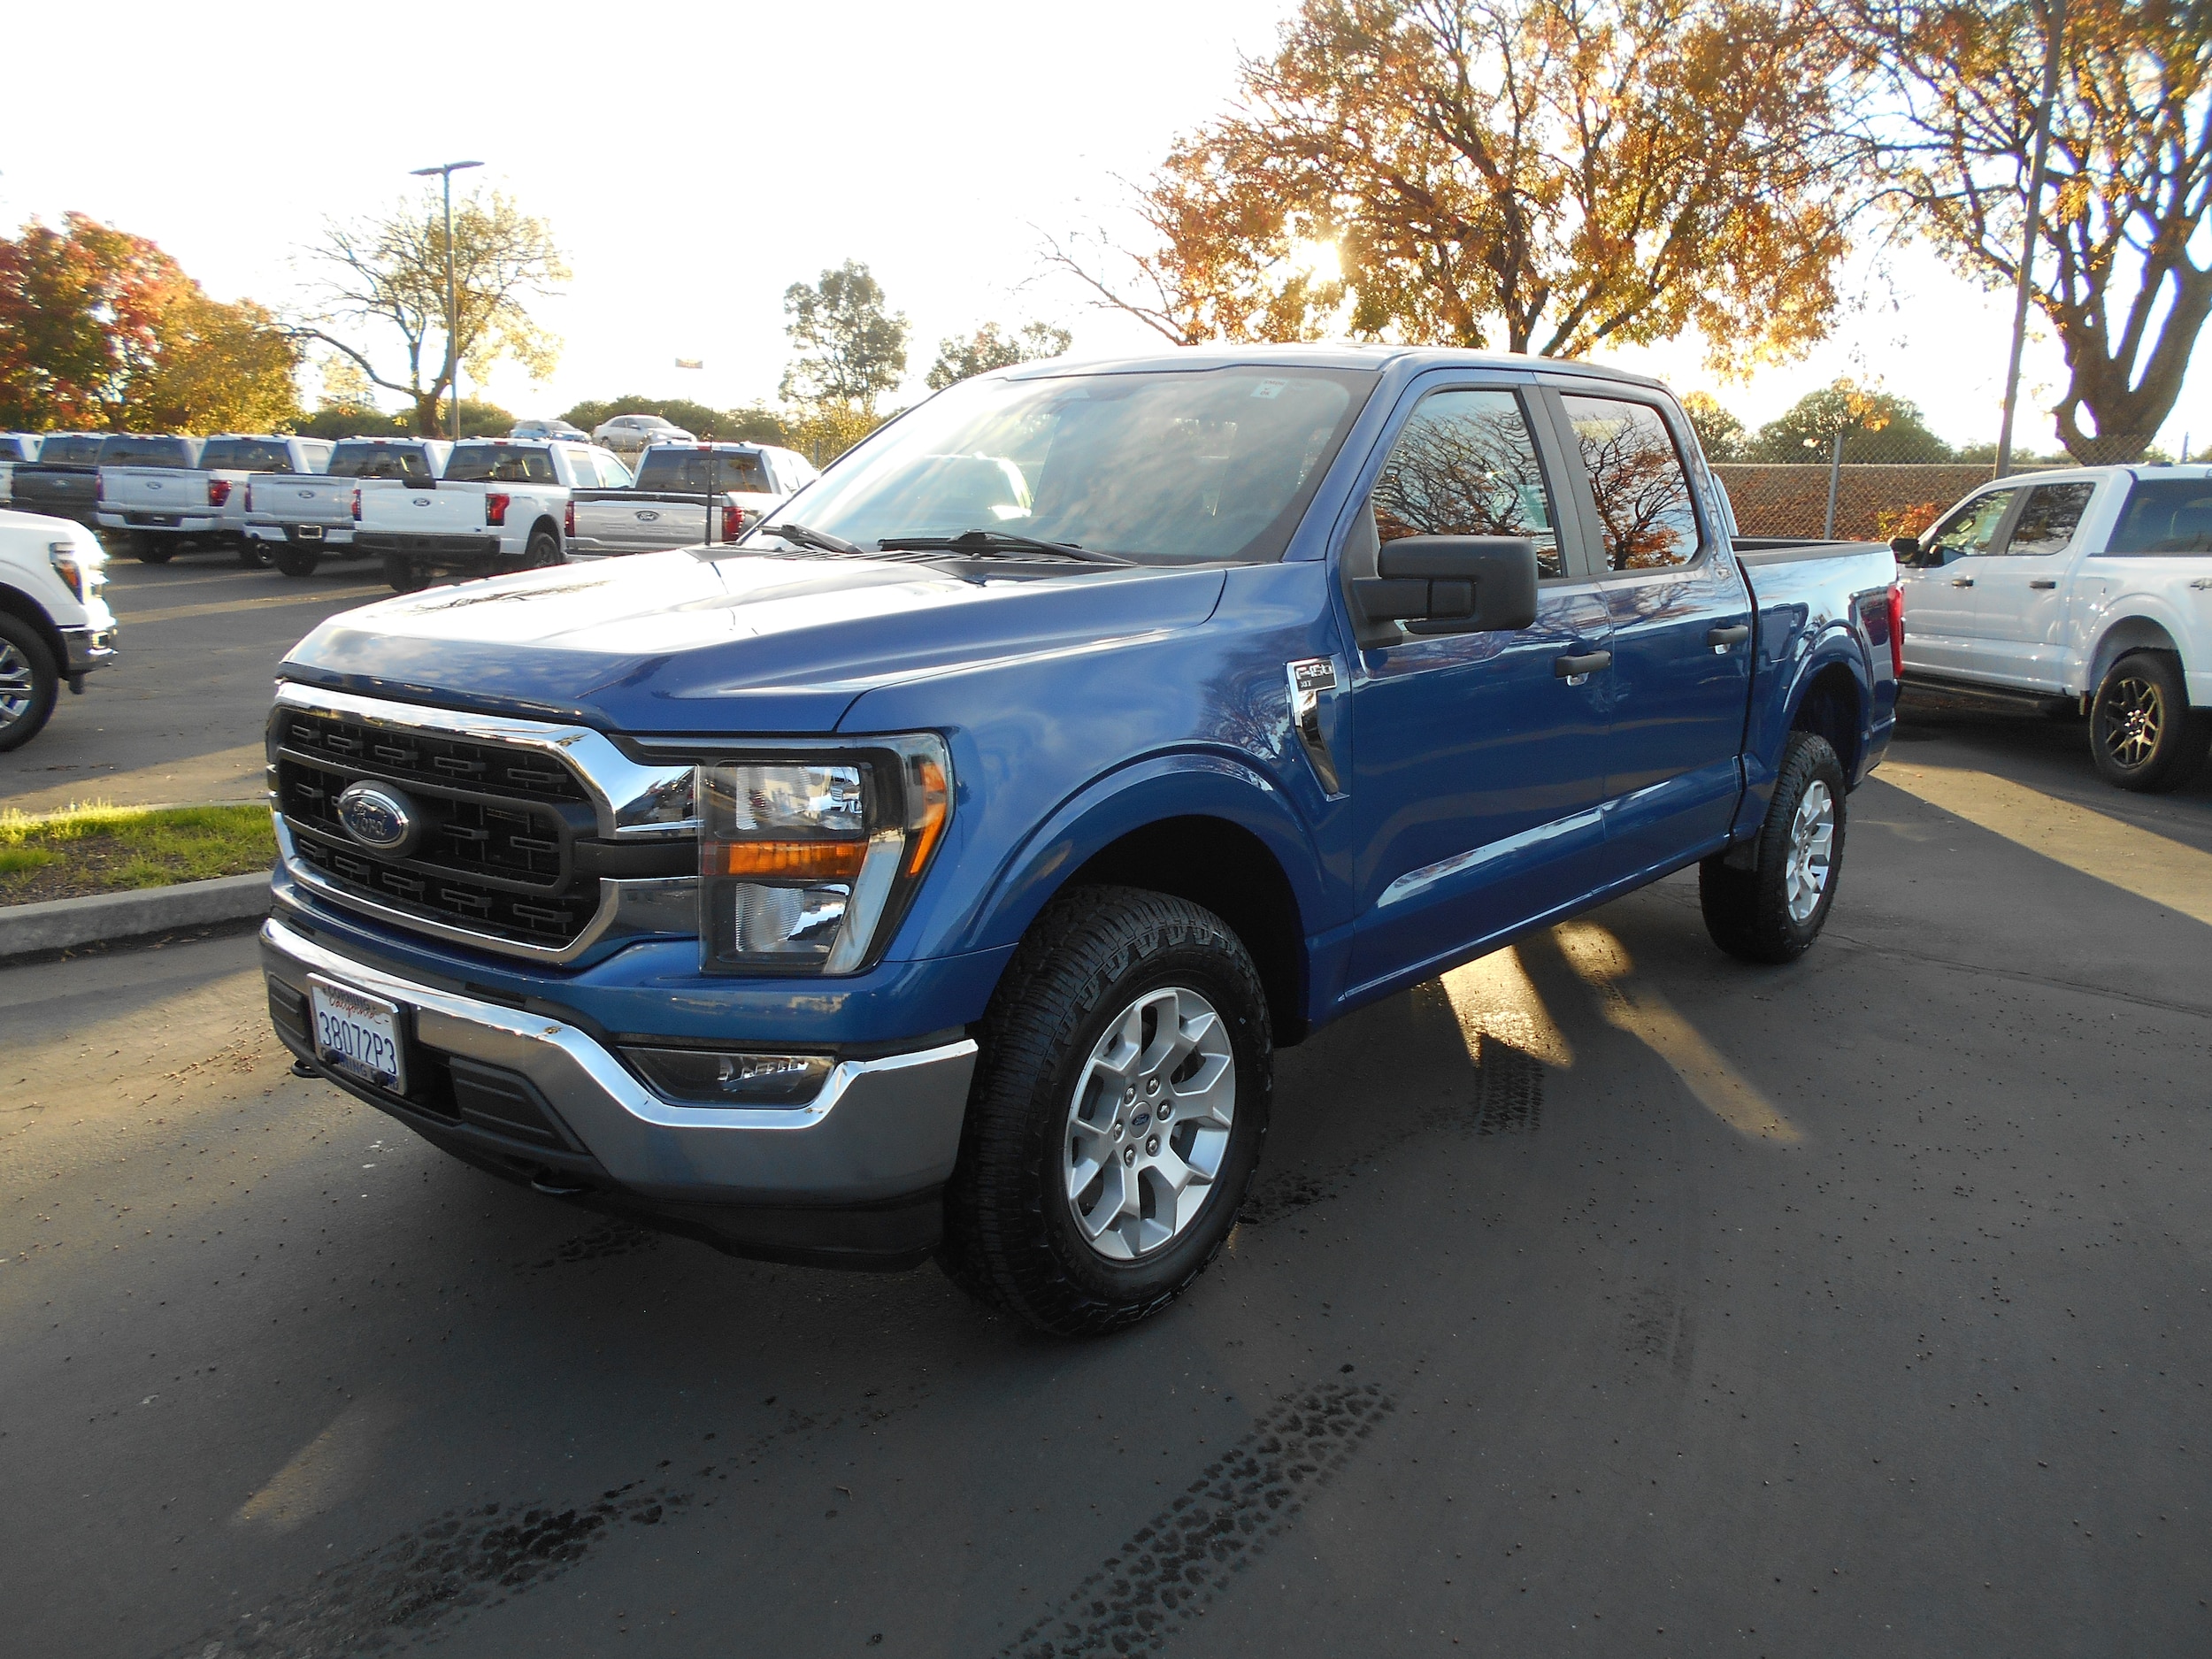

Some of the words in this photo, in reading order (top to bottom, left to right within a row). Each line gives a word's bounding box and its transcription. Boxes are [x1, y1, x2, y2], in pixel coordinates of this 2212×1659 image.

[1295, 664, 1333, 680] F-150
[1300, 680, 1312, 688] XLT
[350, 799, 388, 836] Ford
[319, 1011, 397, 1075] 38072P3
[320, 1047, 367, 1077] CNING
